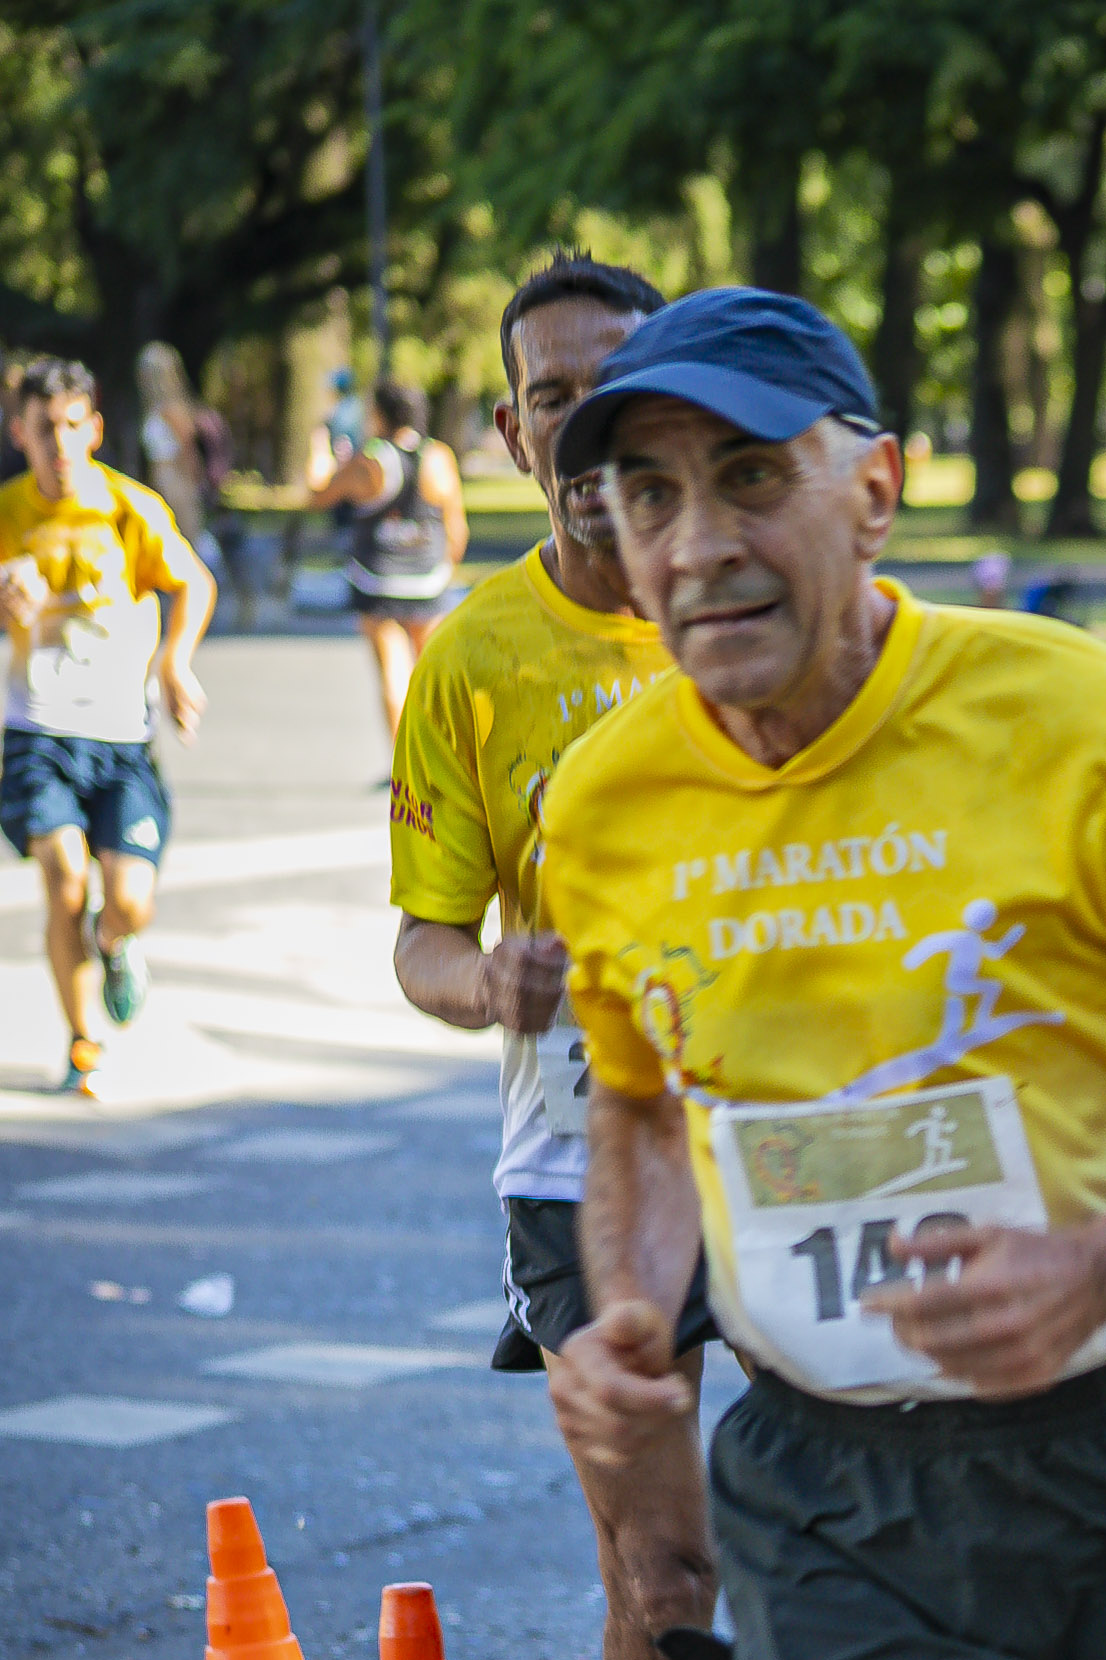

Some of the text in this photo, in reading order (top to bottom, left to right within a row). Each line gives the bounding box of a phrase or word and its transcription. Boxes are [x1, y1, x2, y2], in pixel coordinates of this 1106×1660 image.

[712, 820, 948, 896] MARATÓN
[708, 900, 908, 961] DORADA
[789, 1211, 974, 1322] 14
